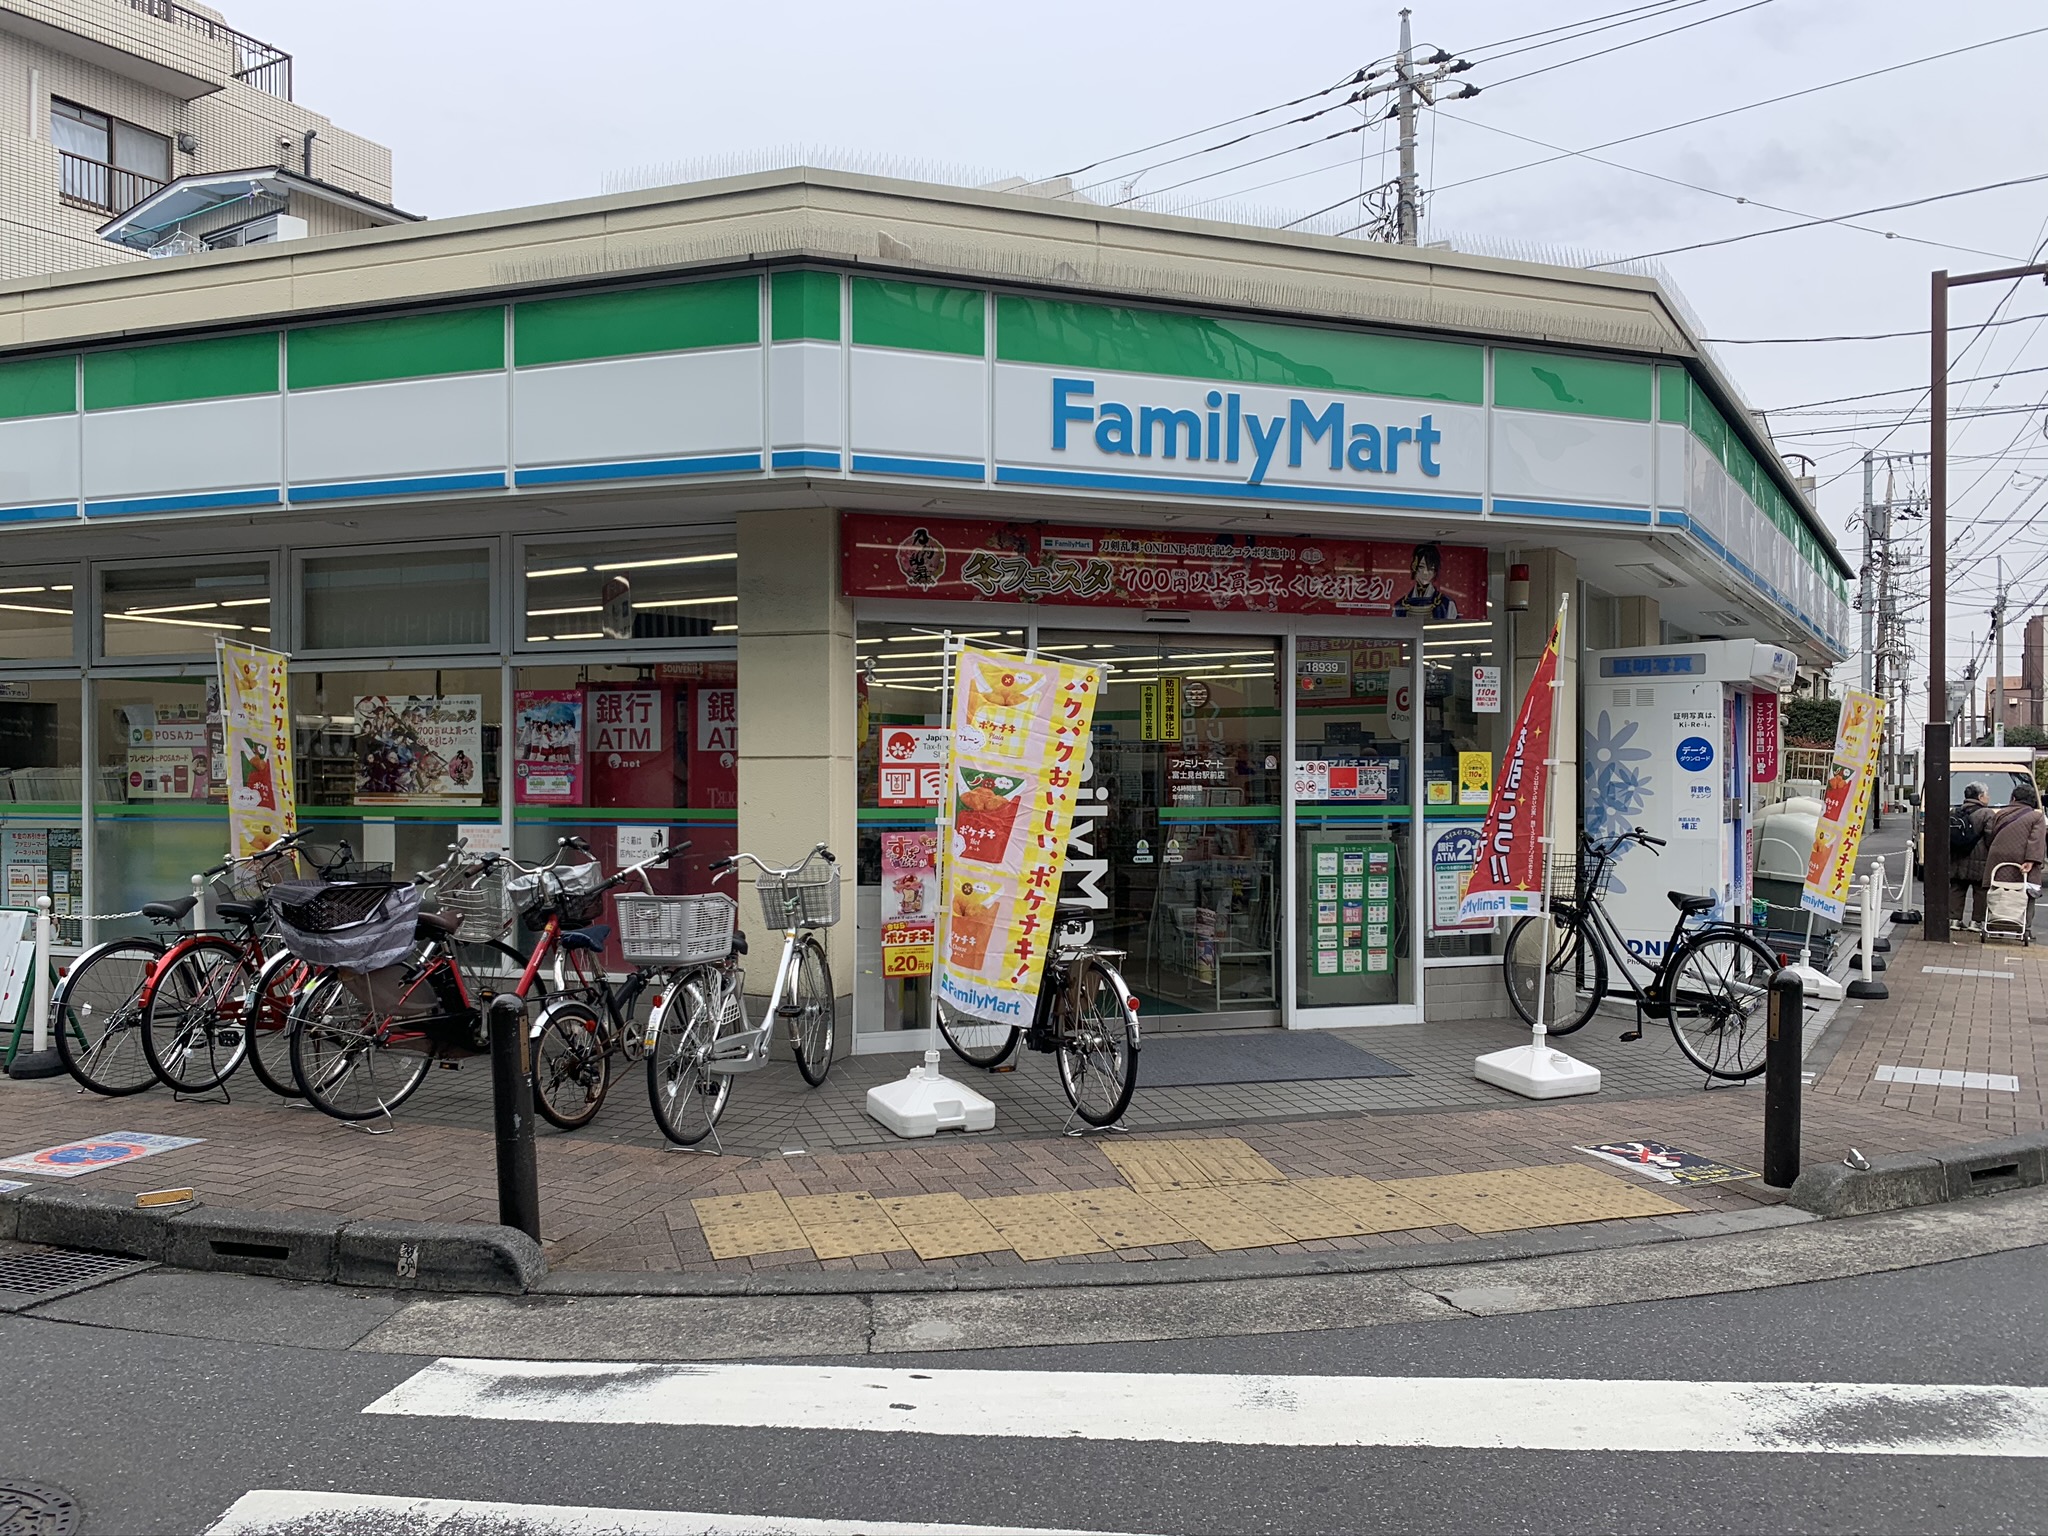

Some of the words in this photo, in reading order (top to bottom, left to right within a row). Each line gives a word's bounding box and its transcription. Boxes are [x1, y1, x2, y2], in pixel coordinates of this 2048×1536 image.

[1051, 377, 1442, 486] FamilyMart
[1054, 540, 1091, 549] FamilyMart
[964, 552, 1110, 595] 冬フェスタ
[1306, 662, 1338, 672] 18939
[1613, 656, 1693, 673] 証明写真
[596, 693, 652, 723] 銀行
[1165, 680, 1175, 738] 防犯対策強化中
[978, 720, 1016, 735] ポケチキ
[1766, 702, 1775, 766] マイナンバーカード
[596, 727, 650, 750] ATM
[1681, 746, 1708, 755] データ
[1171, 759, 1224, 768] ファミリーマート
[1171, 770, 1225, 780] 富士見台駅前店
[1171, 785, 1203, 793] 24時間営業
[1330, 789, 1357, 797] SECOM
[959, 825, 996, 839] ポケチキ
[1010, 675, 1094, 984] パクパクおいしい、ポケチキ!
[620, 837, 642, 845] ゴミ箱は
[1437, 842, 1455, 852] 銀行
[1435, 853, 1457, 862] ATM
[950, 931, 977, 945] ケチキ
[948, 981, 1021, 1016] FamilyMart
